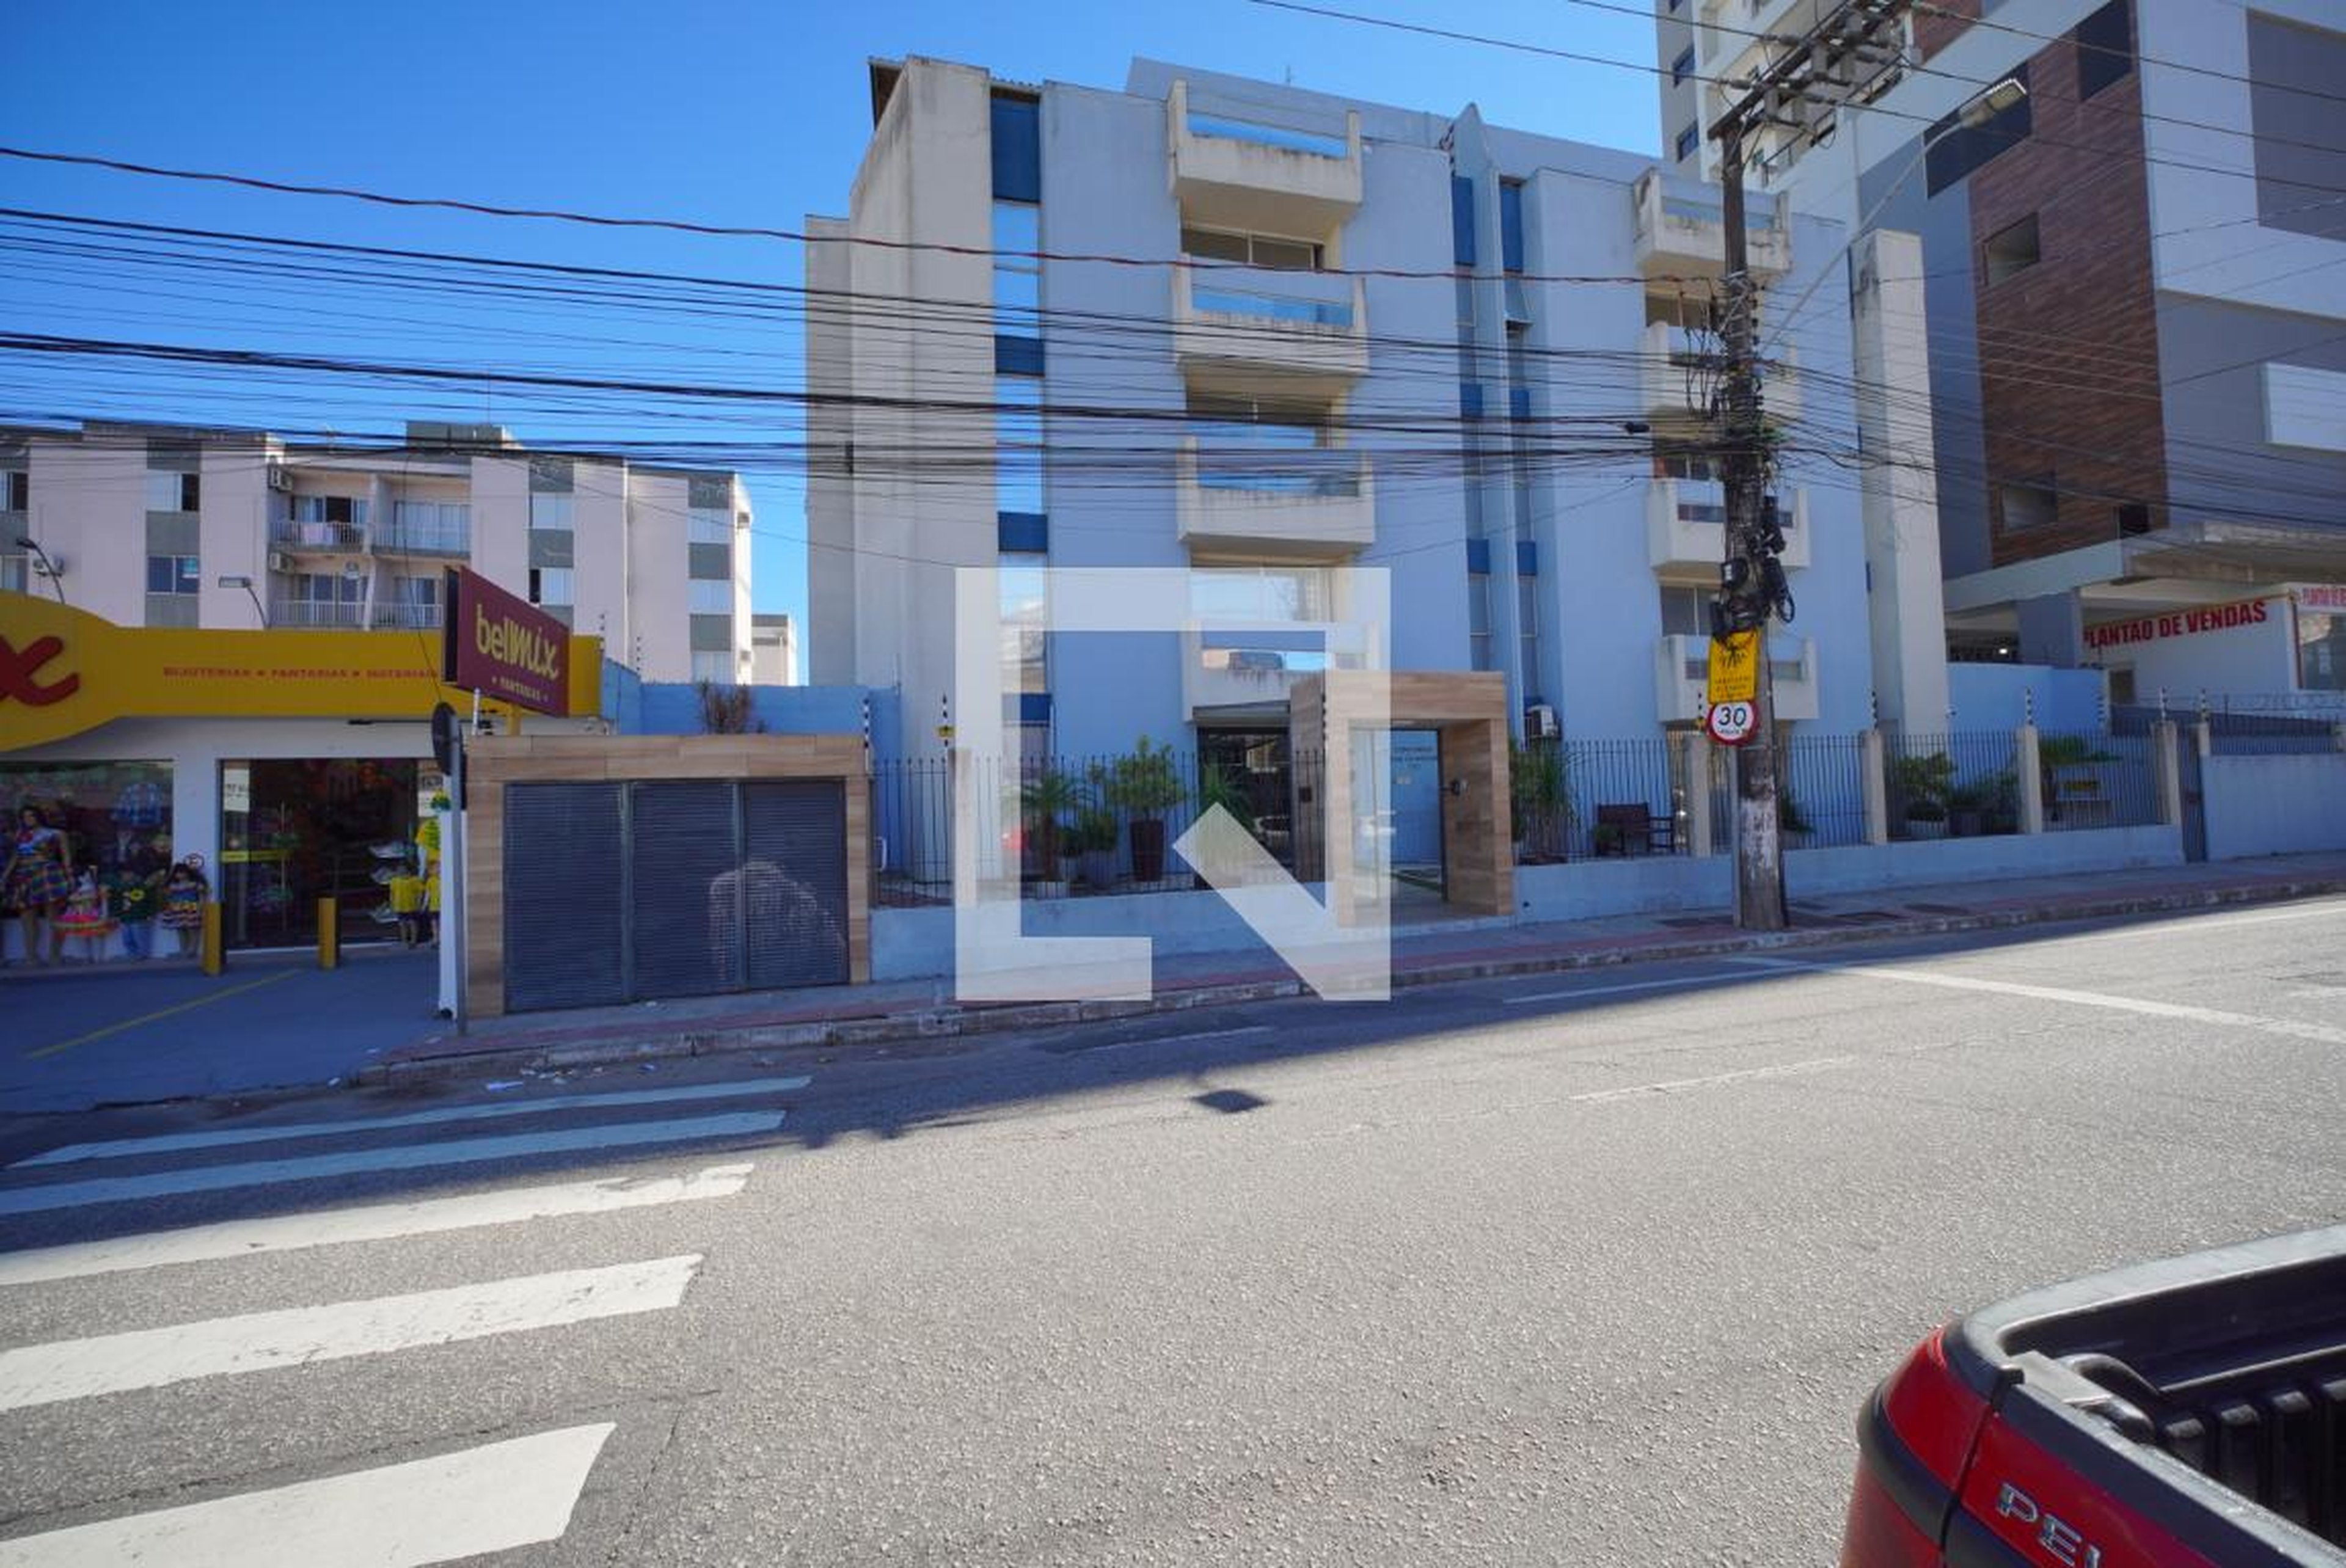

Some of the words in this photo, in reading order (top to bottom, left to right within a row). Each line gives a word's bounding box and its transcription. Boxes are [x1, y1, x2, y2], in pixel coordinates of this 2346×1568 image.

[2159, 616, 2181, 638] DE
[2186, 600, 2267, 633] VENDAS
[1718, 706, 1747, 727] 30
